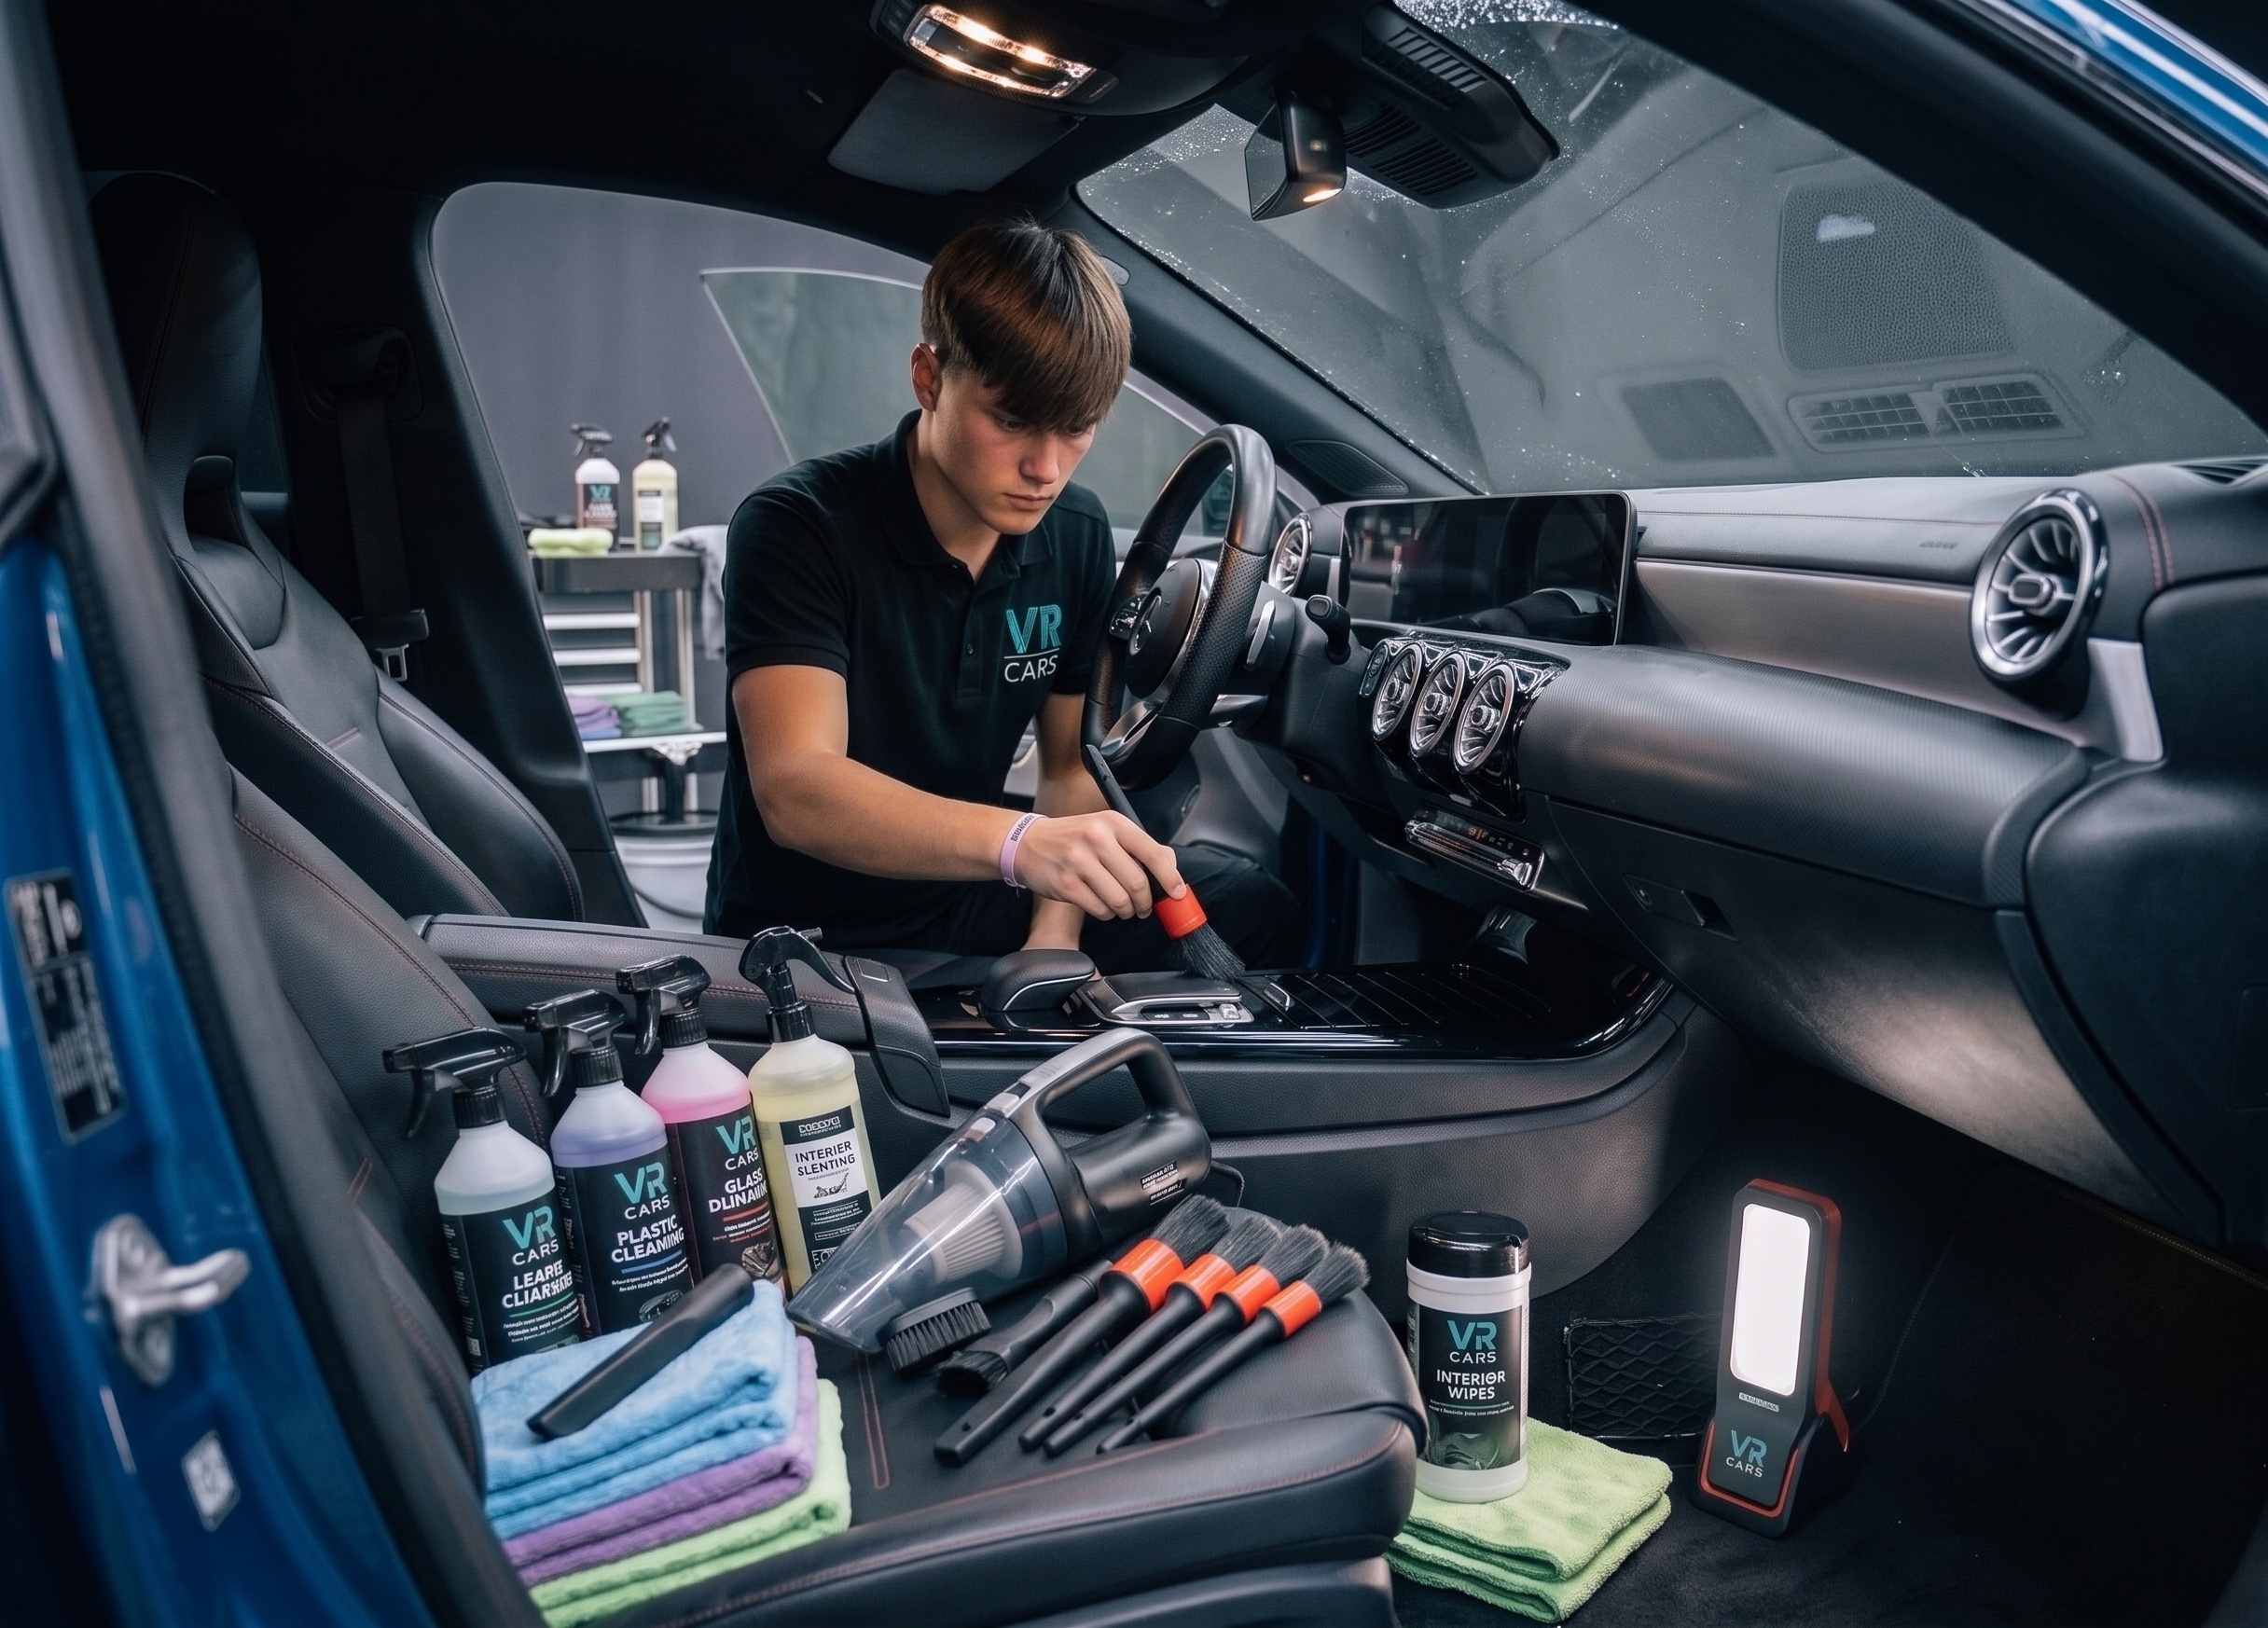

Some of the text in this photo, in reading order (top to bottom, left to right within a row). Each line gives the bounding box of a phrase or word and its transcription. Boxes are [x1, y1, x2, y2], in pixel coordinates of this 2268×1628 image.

[1006, 604, 1062, 654] VR
[1004, 655, 1058, 683] CARS
[715, 1115, 756, 1155] VR
[725, 1147, 759, 1171] CARS
[795, 1140, 852, 1164] INTERIER
[797, 1153, 856, 1177] SLENTING
[614, 1162, 668, 1204] VR
[725, 1167, 763, 1194] GLASS
[624, 1194, 671, 1221] CARS
[502, 1206, 557, 1249] VR
[616, 1214, 678, 1247] PLASTIC
[512, 1238, 560, 1266] CARS
[1447, 1319, 1498, 1351] VR
[1449, 1351, 1497, 1364] CARS
[1436, 1369, 1506, 1386] INTERIOR
[1447, 1386, 1496, 1400] WIPES
[1731, 1429, 1767, 1468] VR
[1726, 1456, 1763, 1478] CARS
